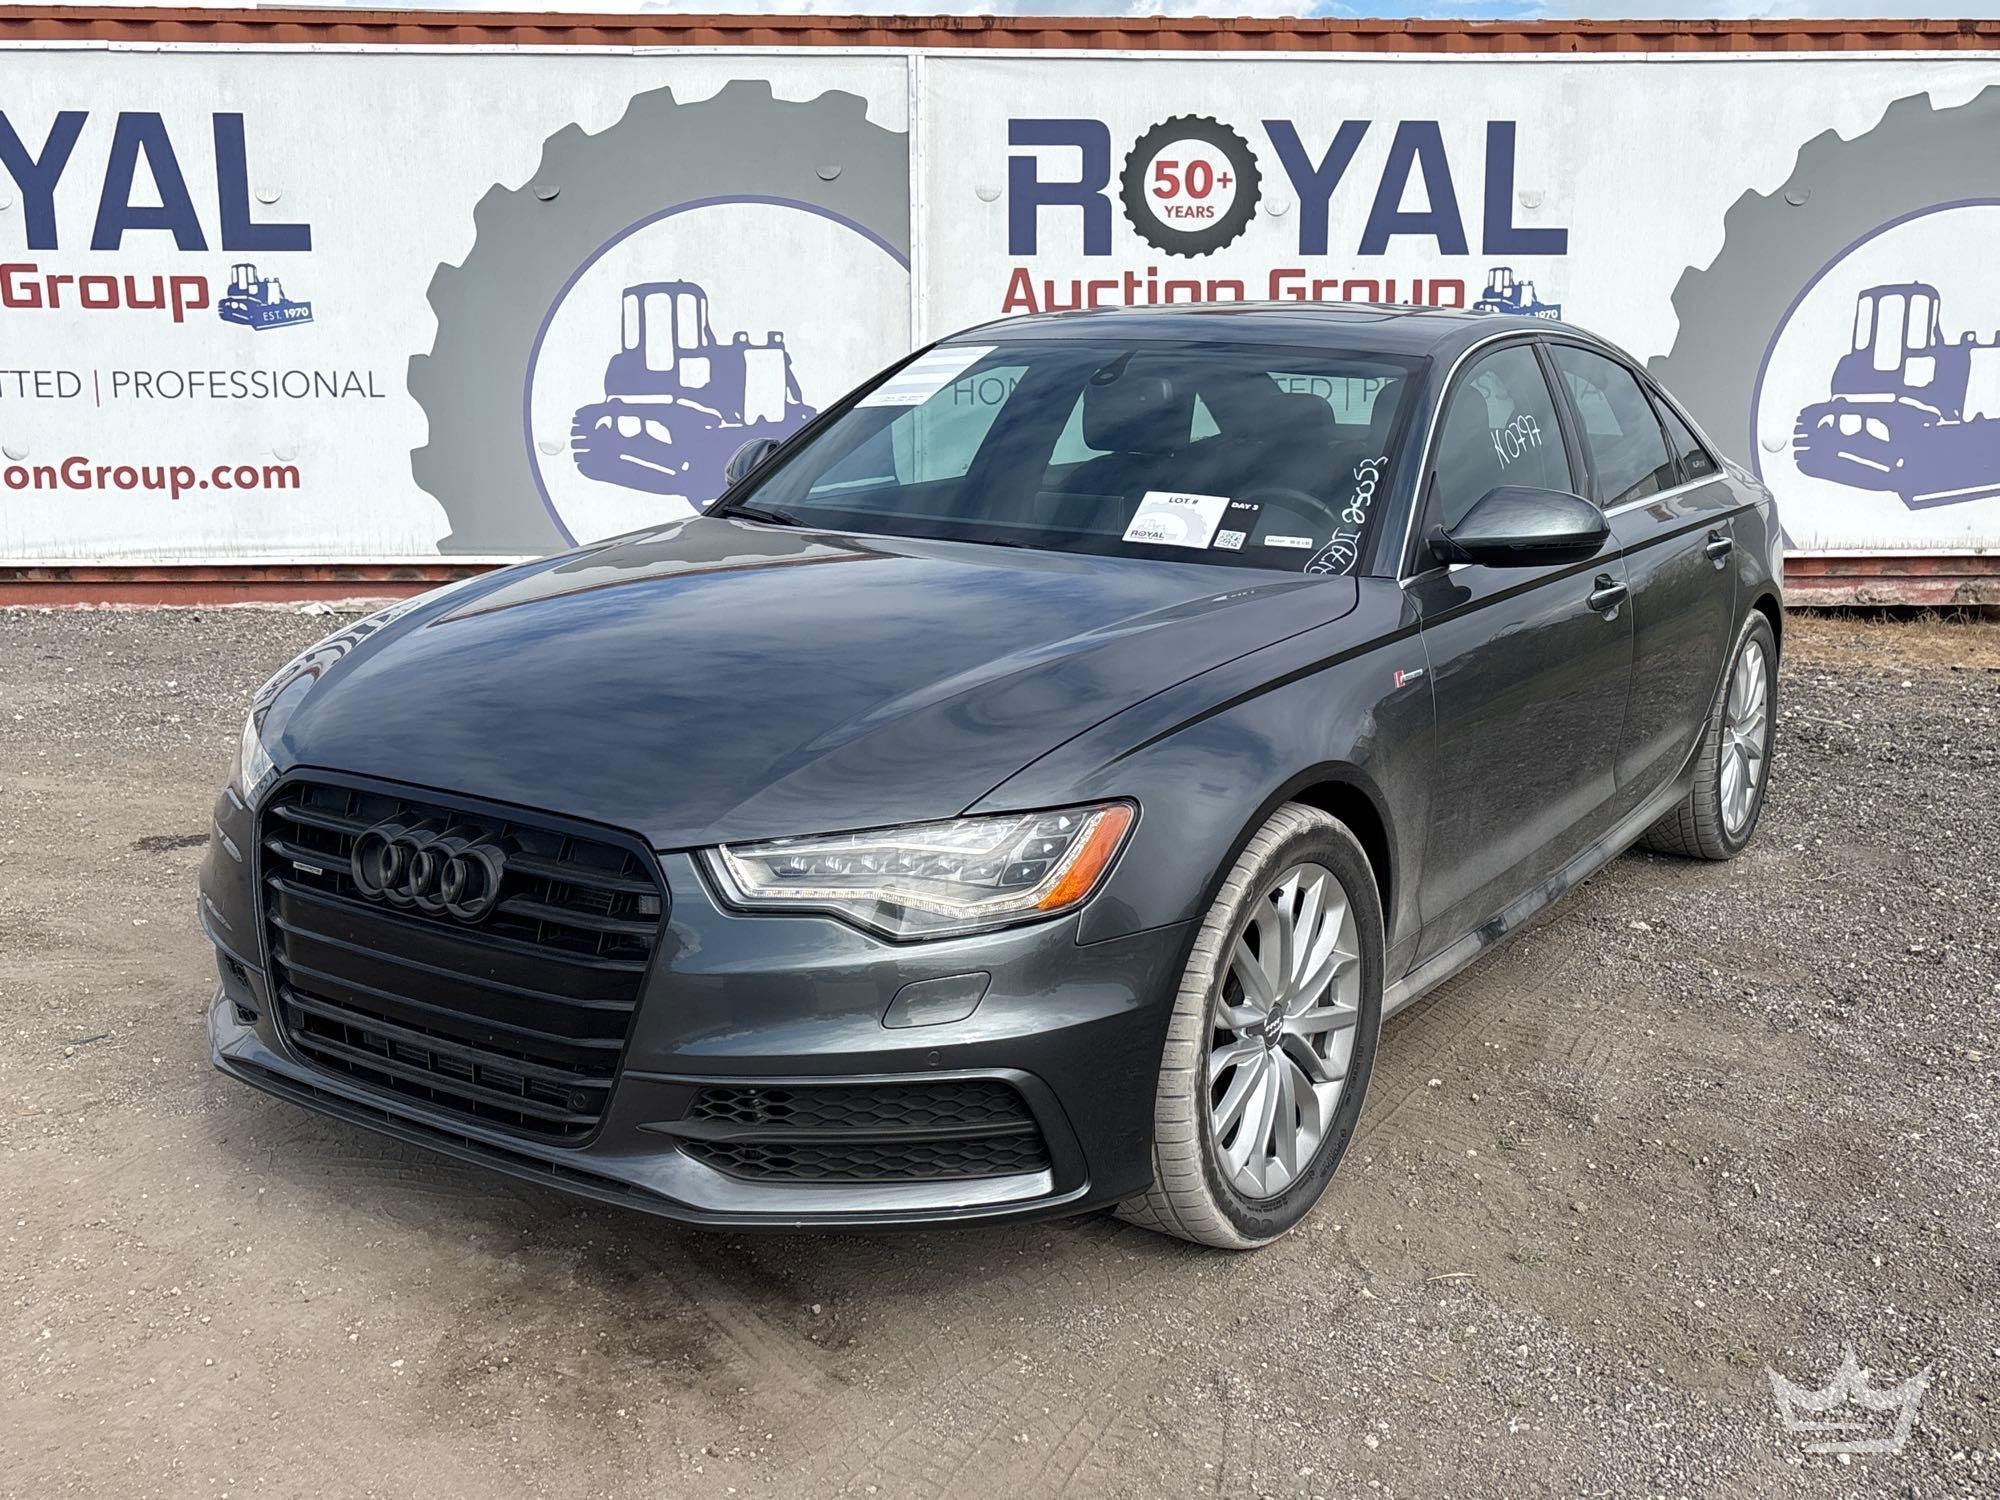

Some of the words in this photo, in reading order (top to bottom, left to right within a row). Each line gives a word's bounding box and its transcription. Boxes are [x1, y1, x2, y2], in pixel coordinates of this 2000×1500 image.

[1152, 159, 1233, 199] 50+
[1164, 205, 1215, 218] YEARS
[0, 263, 209, 323] Group
[1001, 266, 1244, 315] Auction
[262, 311, 282, 321] EST.
[283, 307, 309, 318] 1970
[112, 370, 386, 399] PROFESSIONAL
[3, 456, 300, 500] onGroup.com
[1168, 496, 1190, 505] LOT
[1231, 501, 1252, 510] DAY
[1130, 529, 1165, 539] ROYAL
